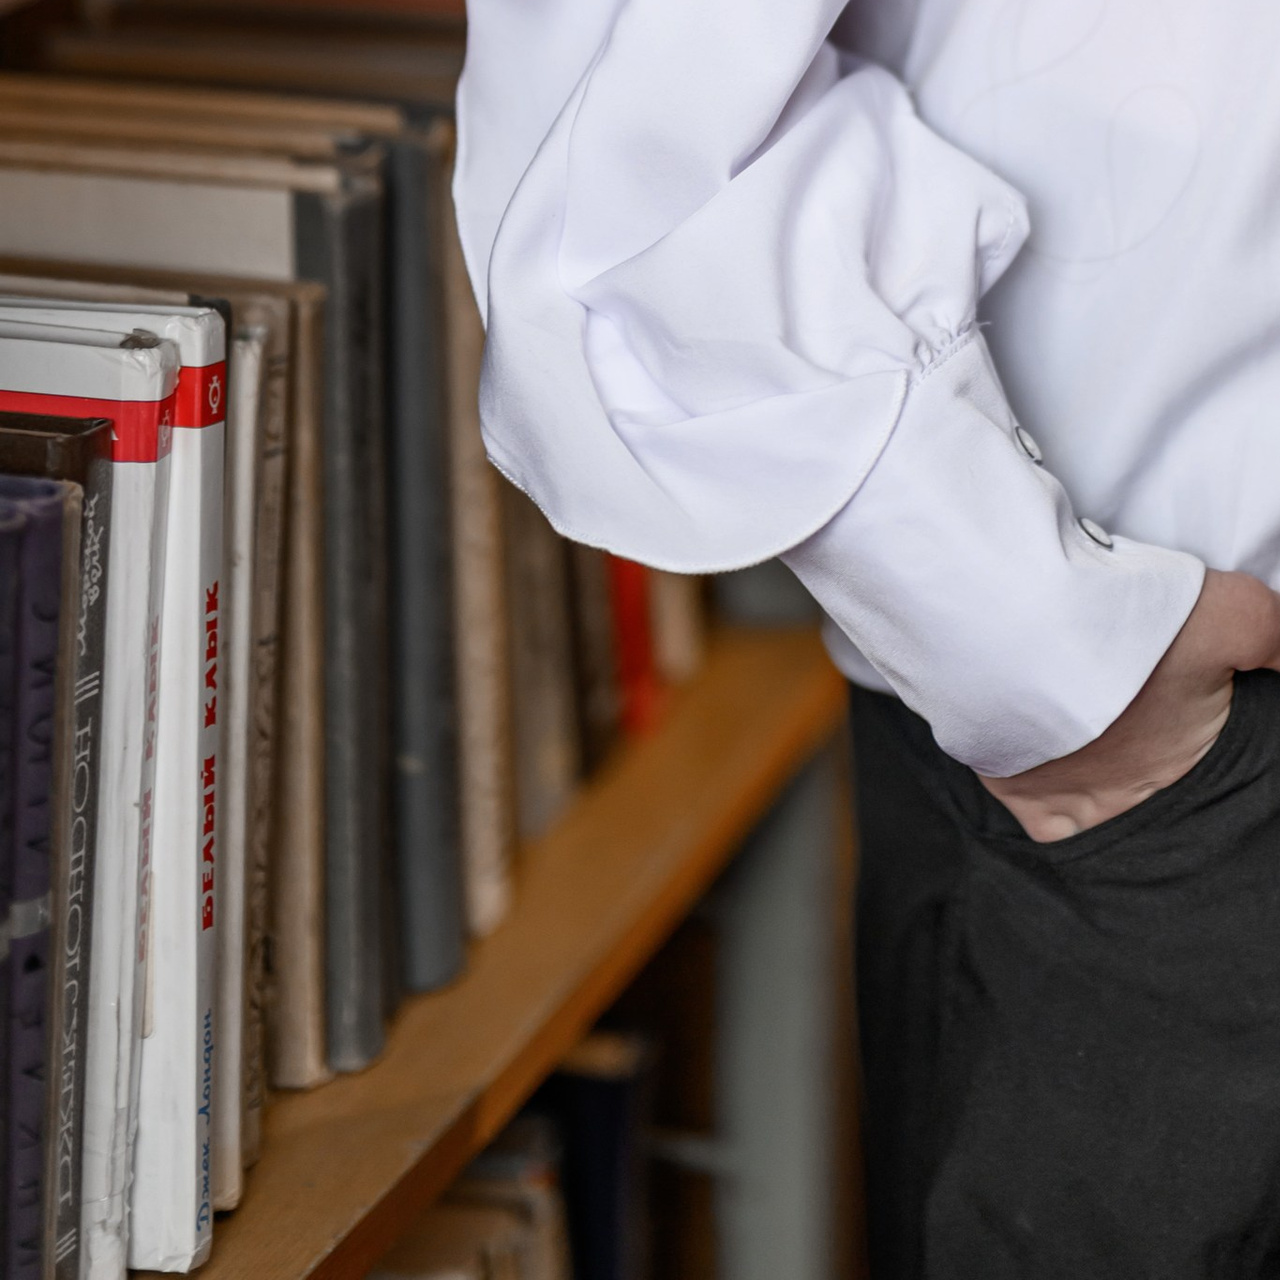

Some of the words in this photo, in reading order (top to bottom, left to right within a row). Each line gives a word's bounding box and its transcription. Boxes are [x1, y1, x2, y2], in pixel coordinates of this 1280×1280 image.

[204, 581, 219, 728] КЛЫК
[201, 754, 216, 931] БЕЛЫЙ
[198, 1008, 213, 1125] Лондон
[195, 1139, 211, 1233] Джек
